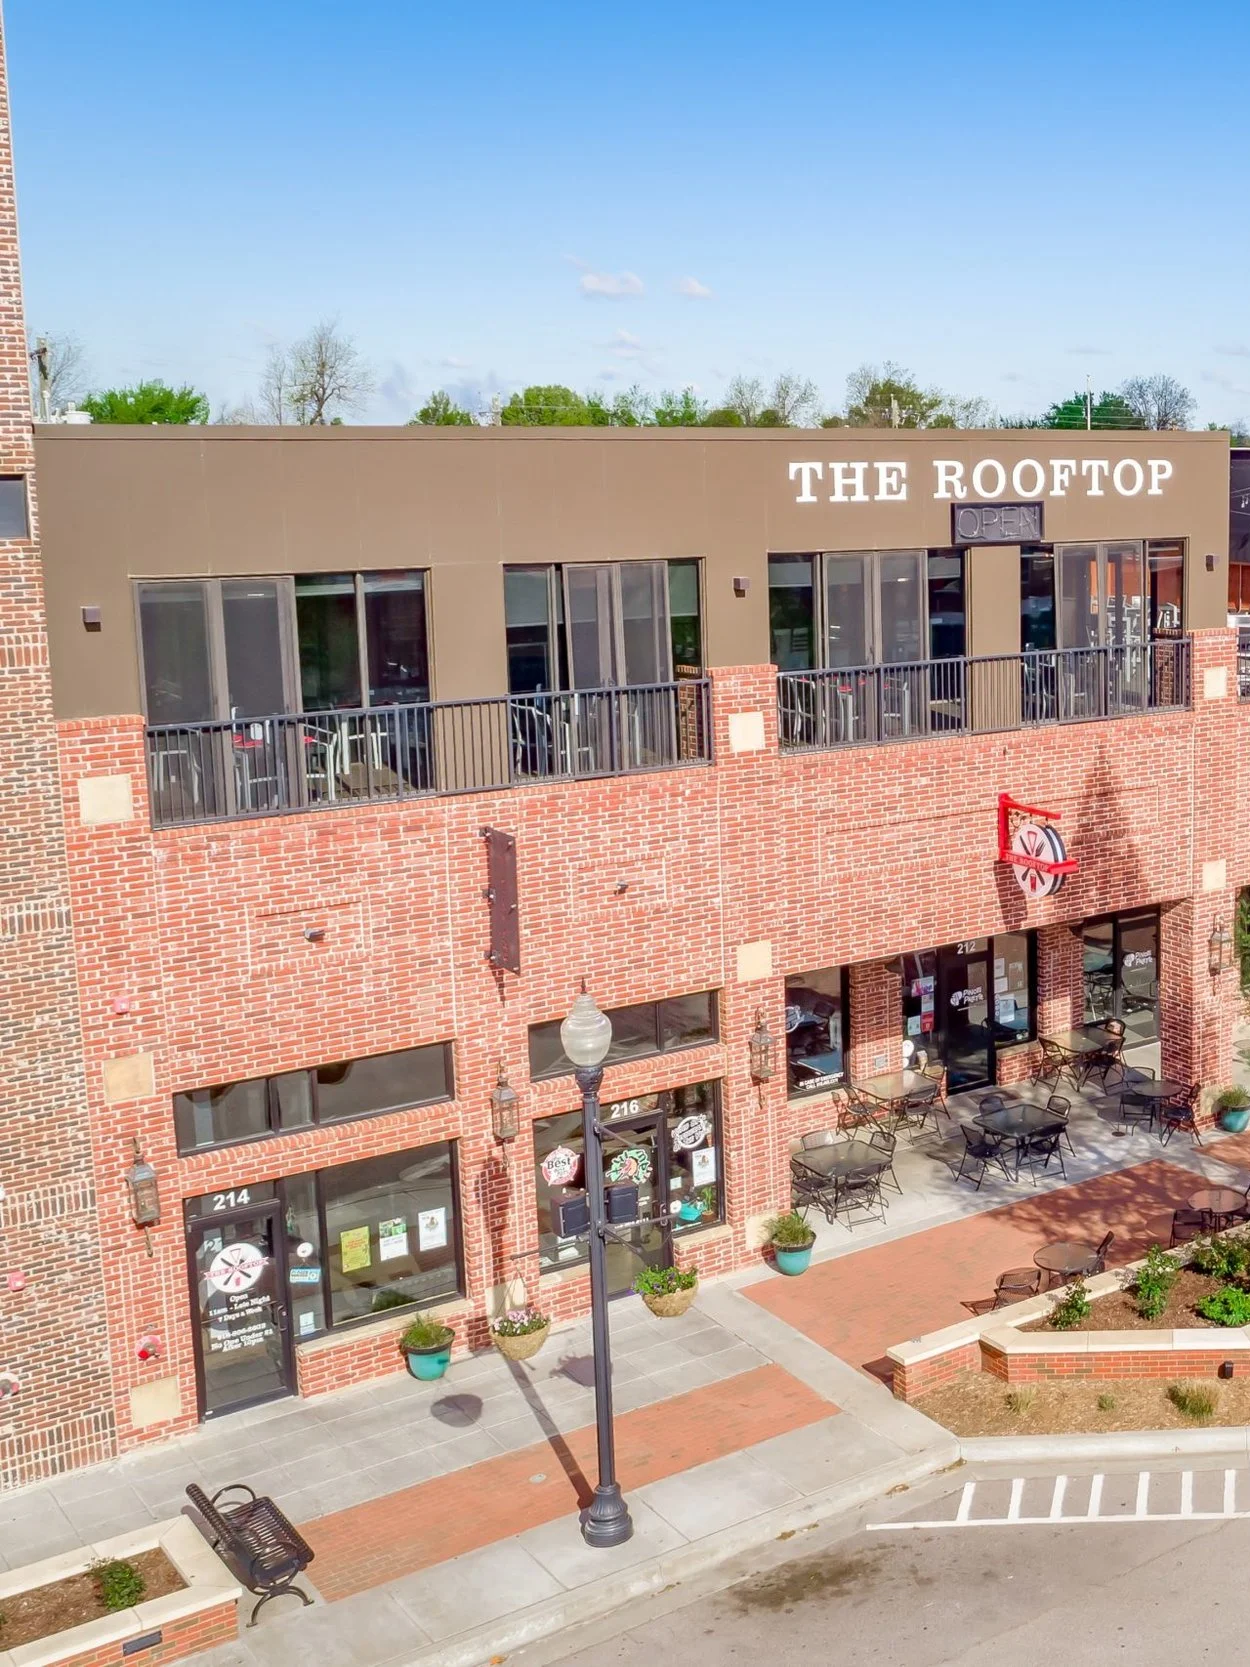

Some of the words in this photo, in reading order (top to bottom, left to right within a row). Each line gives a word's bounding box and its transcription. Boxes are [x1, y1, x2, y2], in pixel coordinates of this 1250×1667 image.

[788, 460, 908, 503] THE
[932, 458, 1174, 500] ROOFTOP
[957, 506, 1040, 541] OPEN
[957, 941, 976, 955] 212
[610, 1100, 640, 1119] 216
[547, 1156, 571, 1170] Best
[213, 1188, 250, 1211] 214
[229, 1293, 249, 1304] Open
[224, 1311, 240, 1322] Days
